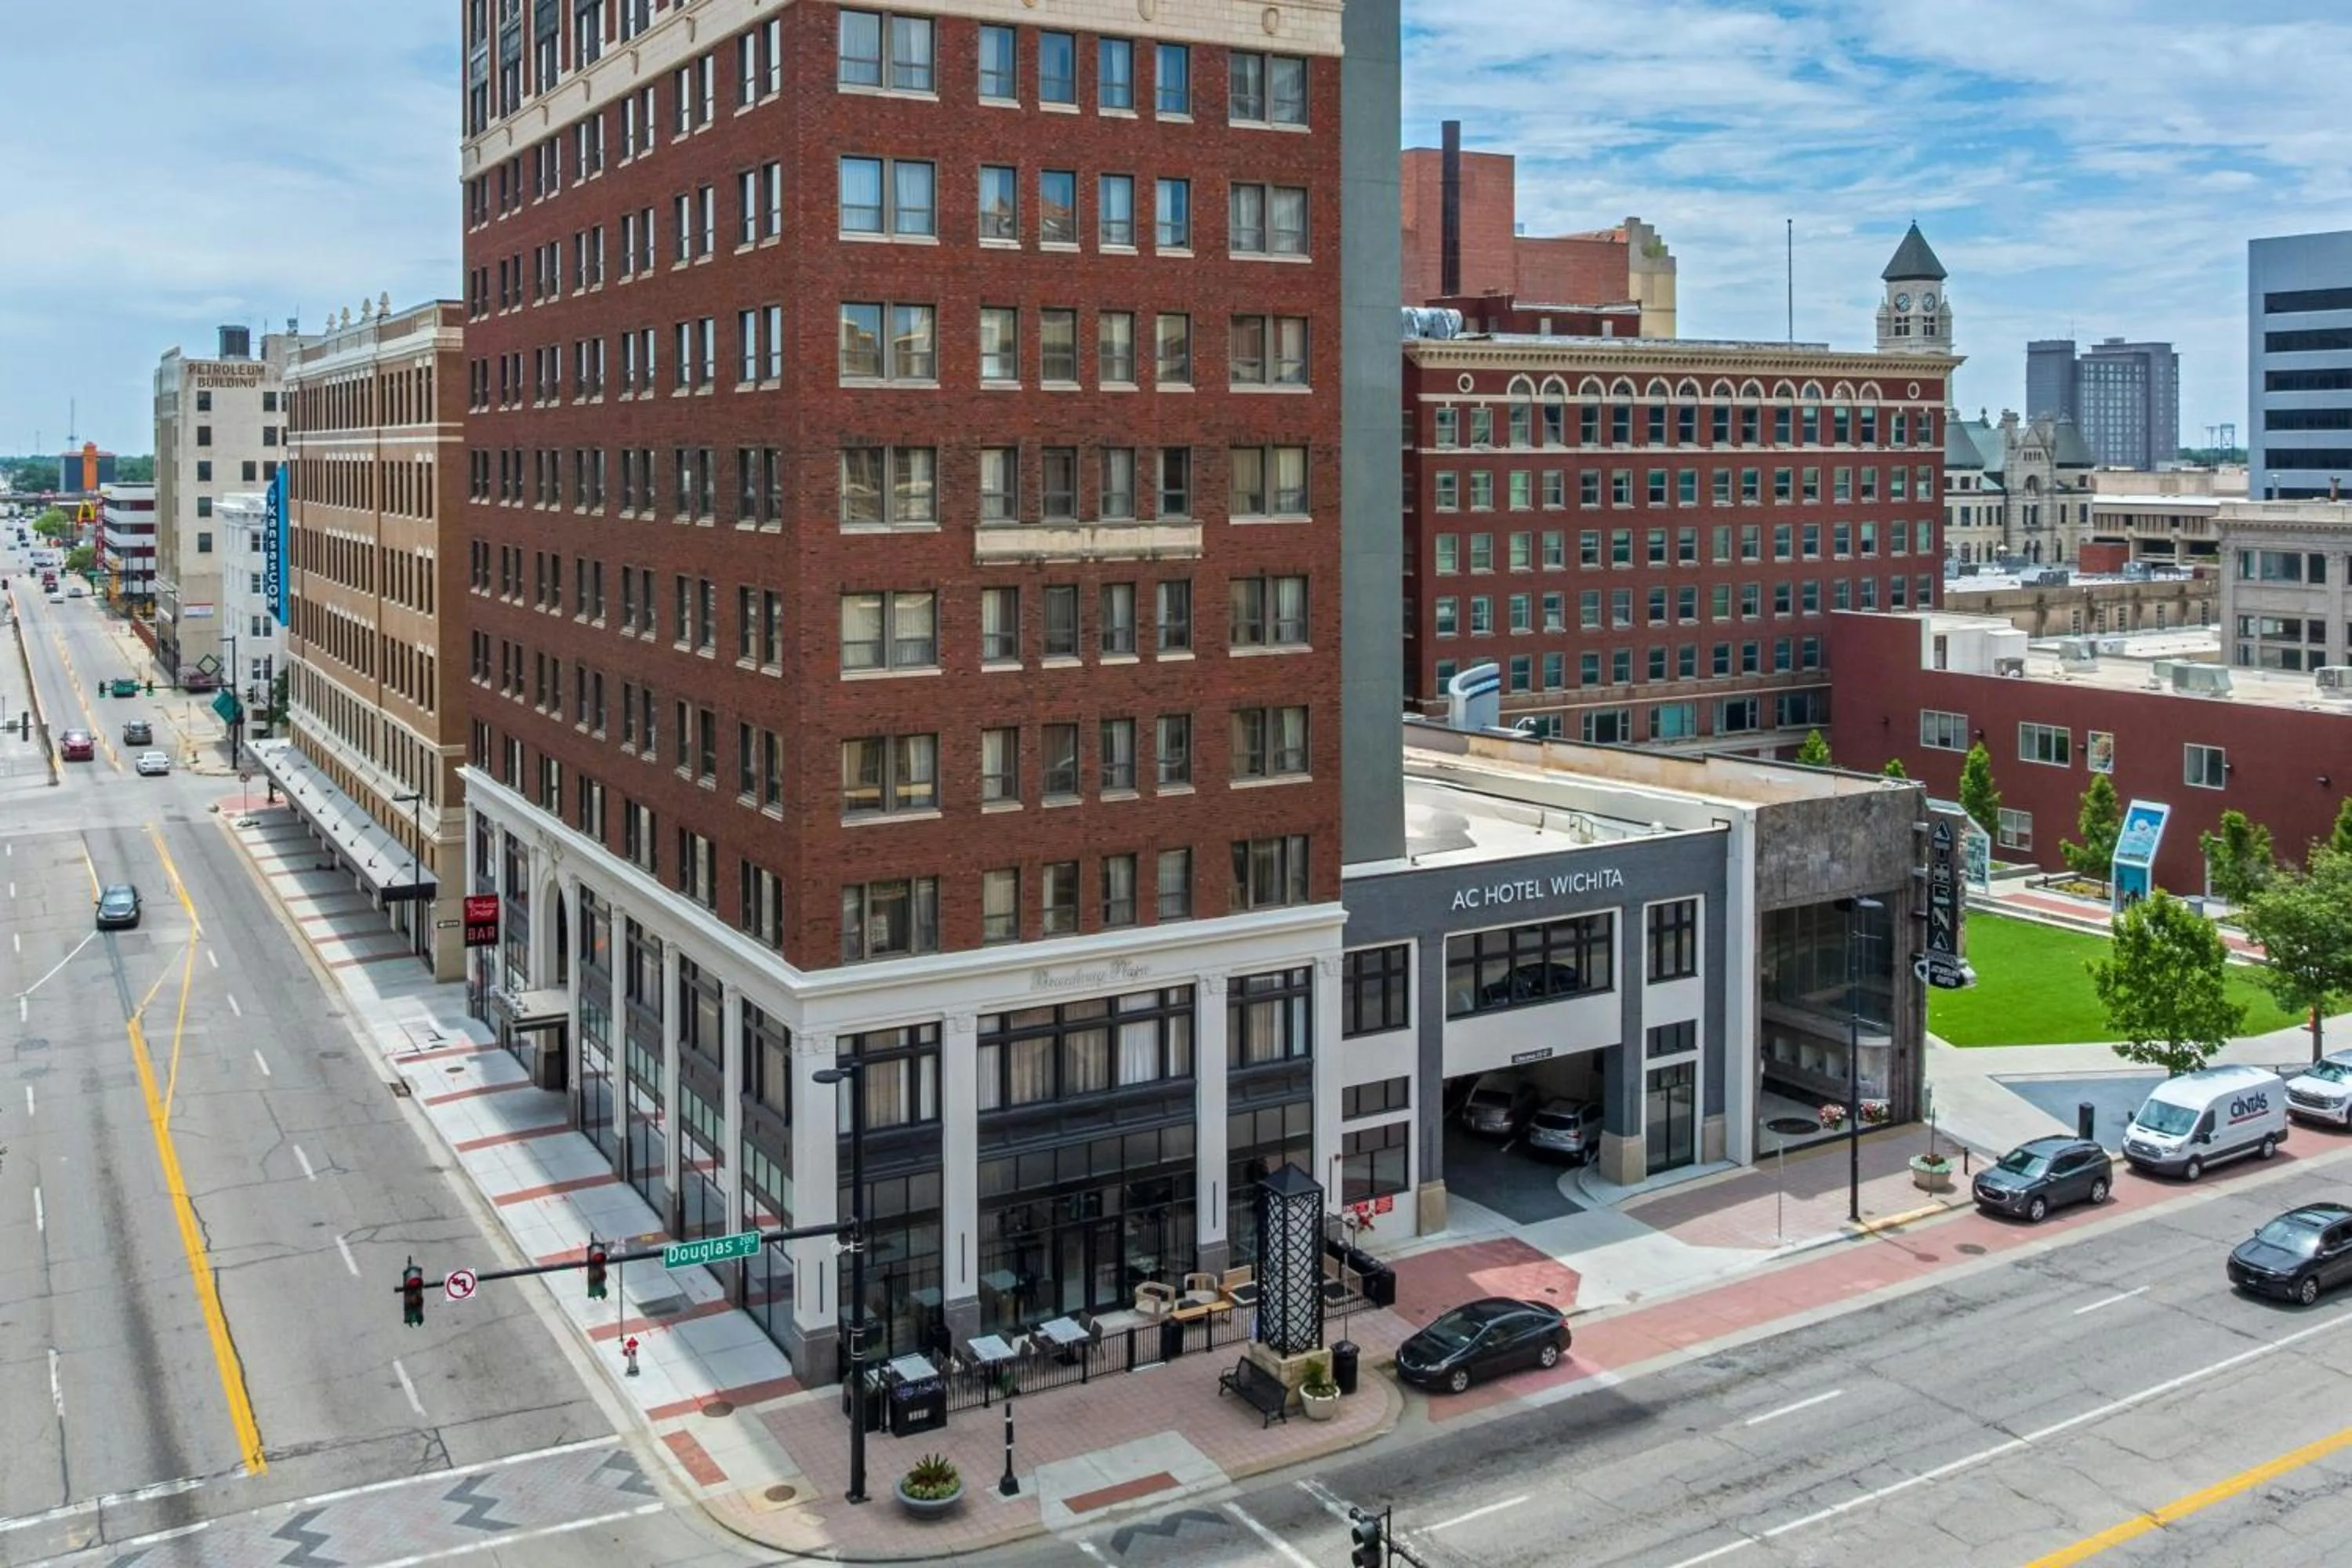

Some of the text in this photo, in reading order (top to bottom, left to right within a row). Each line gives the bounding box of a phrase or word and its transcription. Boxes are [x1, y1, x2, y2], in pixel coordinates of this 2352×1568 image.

[188, 363, 265, 376] PETROLEUM
[198, 376, 256, 387] BUILDING
[1451, 869, 1624, 909] AC HOTEL WICHITA
[1933, 821, 1951, 951] ATHENA
[467, 927, 495, 941] BAR
[739, 1235, 755, 1246] 200
[669, 1241, 733, 1263] Douglas
[744, 1244, 751, 1254] E
